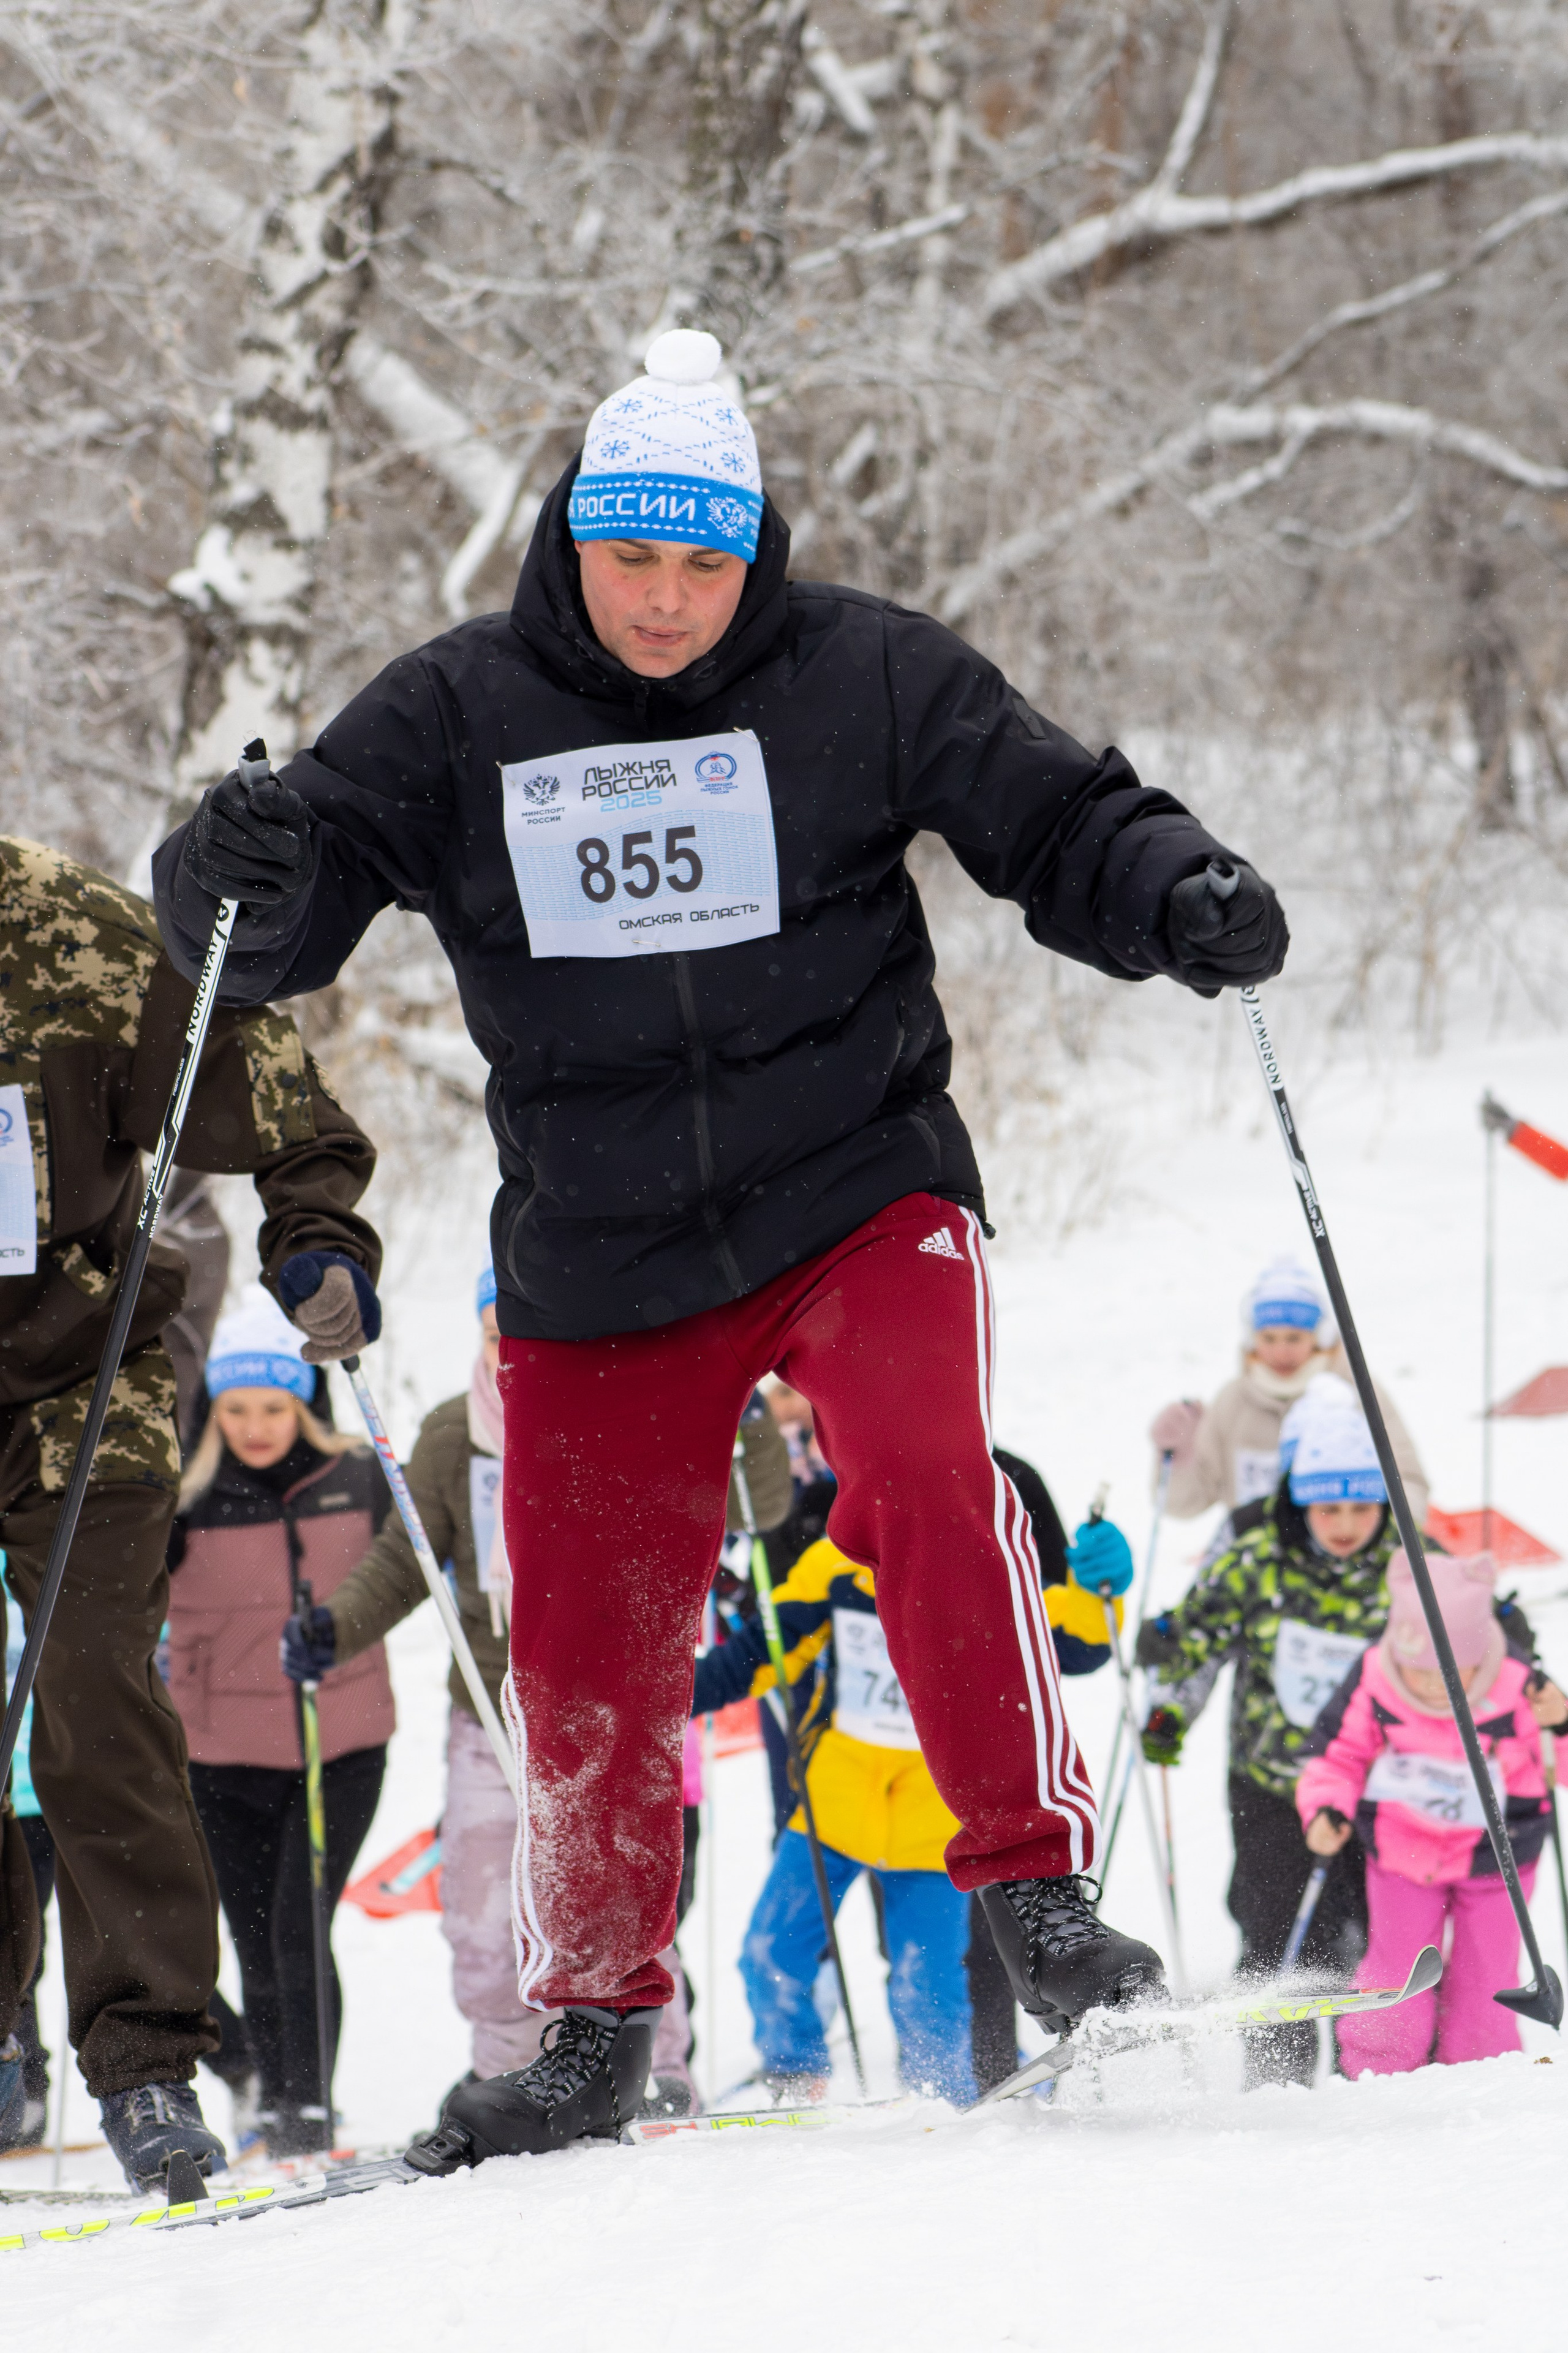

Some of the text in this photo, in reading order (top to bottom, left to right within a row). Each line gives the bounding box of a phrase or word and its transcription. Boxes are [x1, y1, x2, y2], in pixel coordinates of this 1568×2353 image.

[578, 493, 696, 521] РОССИИ
[584, 759, 671, 785] ЛЫЖНЯ
[581, 773, 677, 801] РОССИИ
[600, 790, 663, 812] 2025
[521, 807, 566, 818] МИНСПОРТ
[527, 815, 561, 825] РОССИИ
[576, 825, 703, 904] 855
[619, 903, 760, 930] ОМСКАЯ ОБЛАСТЬ
[188, 939, 218, 1036] NORDWAY
[1249, 1009, 1282, 1084] NORDWAY
[137, 1169, 156, 1231] XC ACTIVE
[148, 1193, 164, 1238] NORDWAY
[0, 1247, 26, 1258] СТЬ
[918, 1242, 965, 1261] adidas
[863, 1668, 910, 1714] 74
